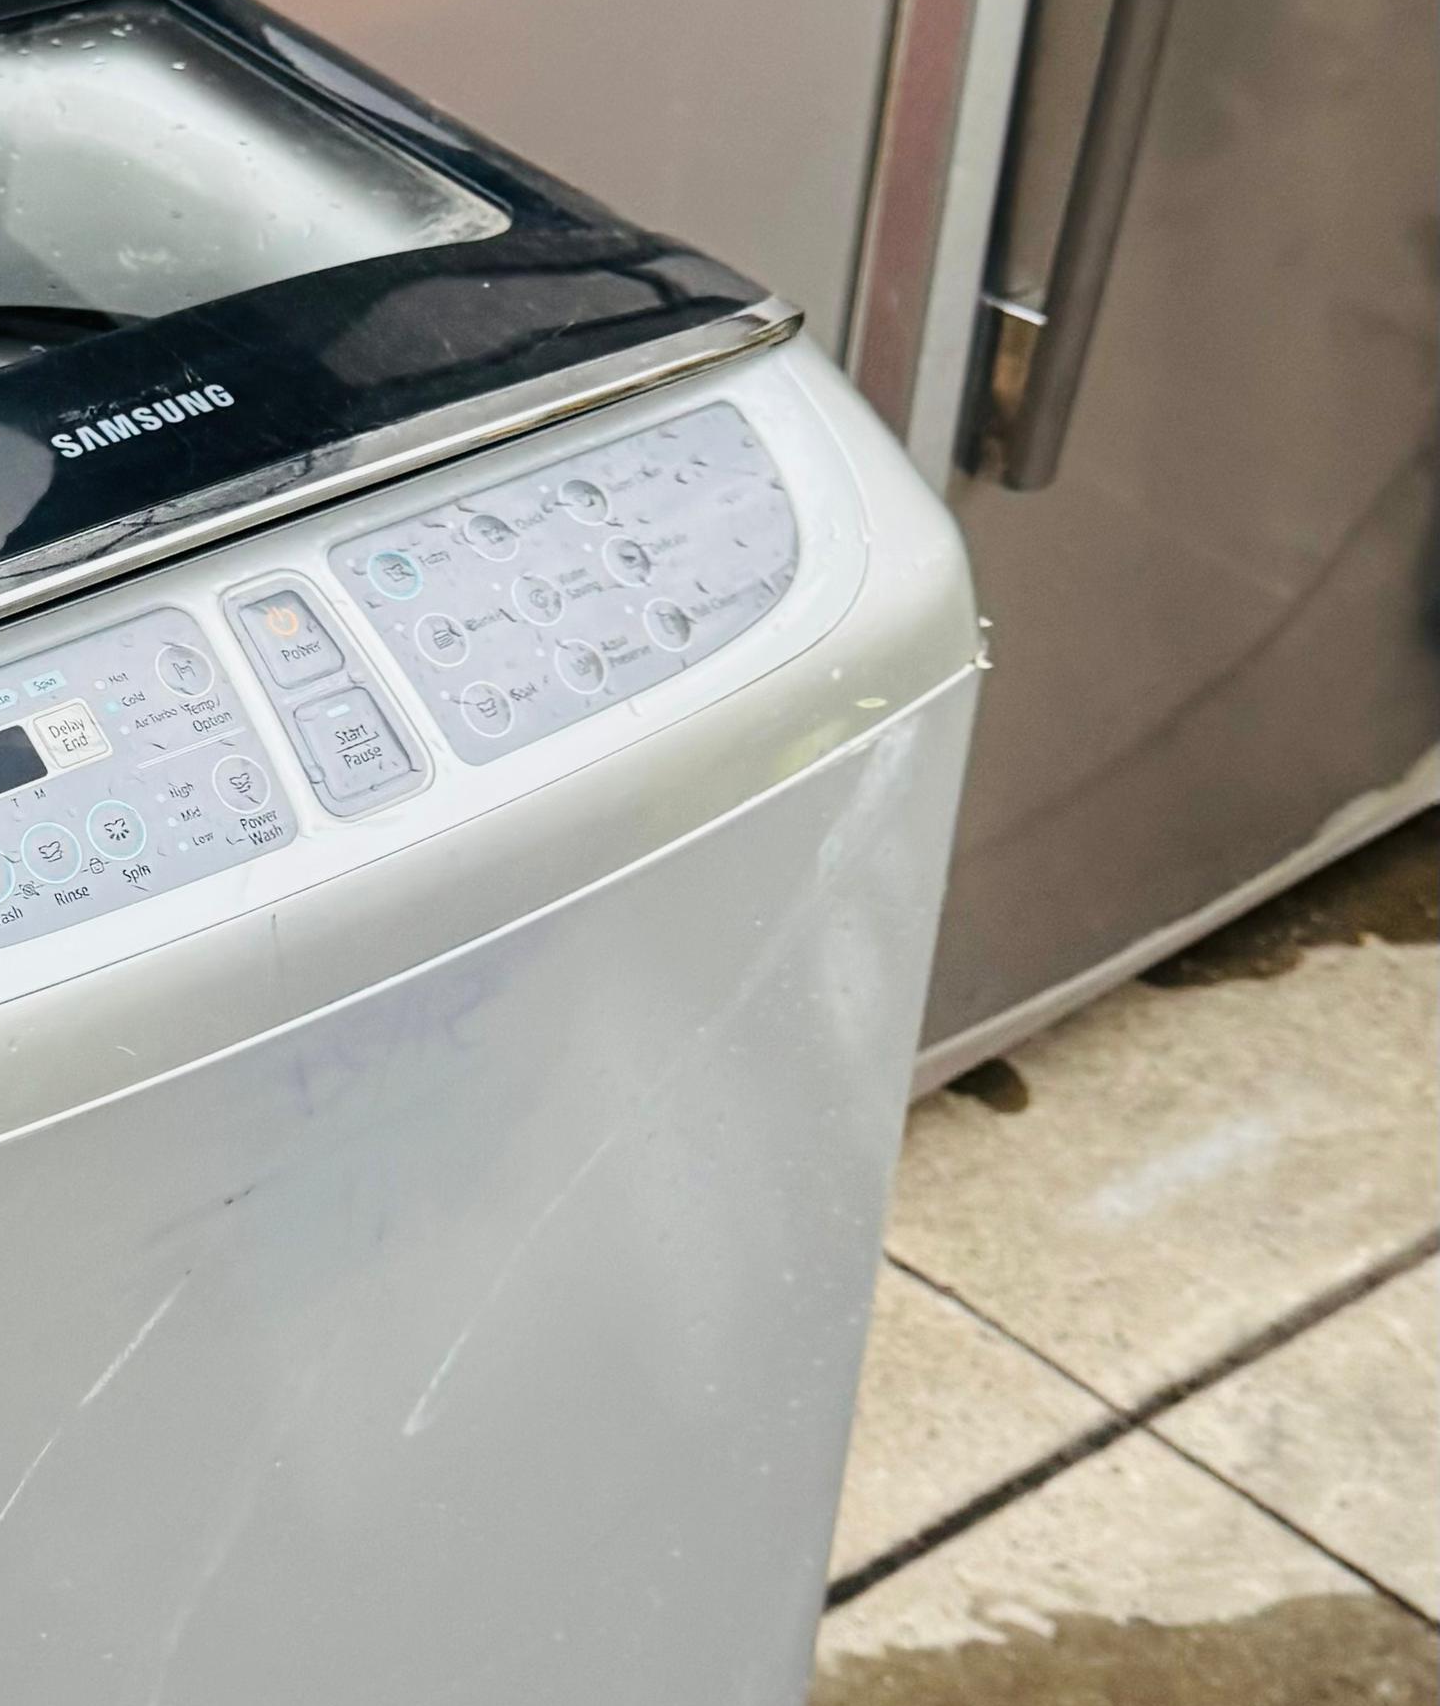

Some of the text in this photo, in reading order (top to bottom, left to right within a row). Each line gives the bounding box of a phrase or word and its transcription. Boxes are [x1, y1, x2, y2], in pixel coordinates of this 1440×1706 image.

[50, 383, 235, 459] SAMSUNG
[280, 640, 323, 663] Power
[33, 676, 58, 693] Spin
[121, 690, 147, 708] Cold
[148, 706, 178, 724] Turbo
[191, 710, 234, 734] Option
[48, 714, 87, 740] Delay
[335, 723, 370, 746] Start
[62, 733, 90, 754] End
[342, 745, 384, 771] Pause
[239, 809, 279, 832] Power
[191, 831, 215, 847] Low
[248, 823, 285, 847] Wash
[121, 863, 152, 886] Spin
[53, 884, 91, 908] Rinse
